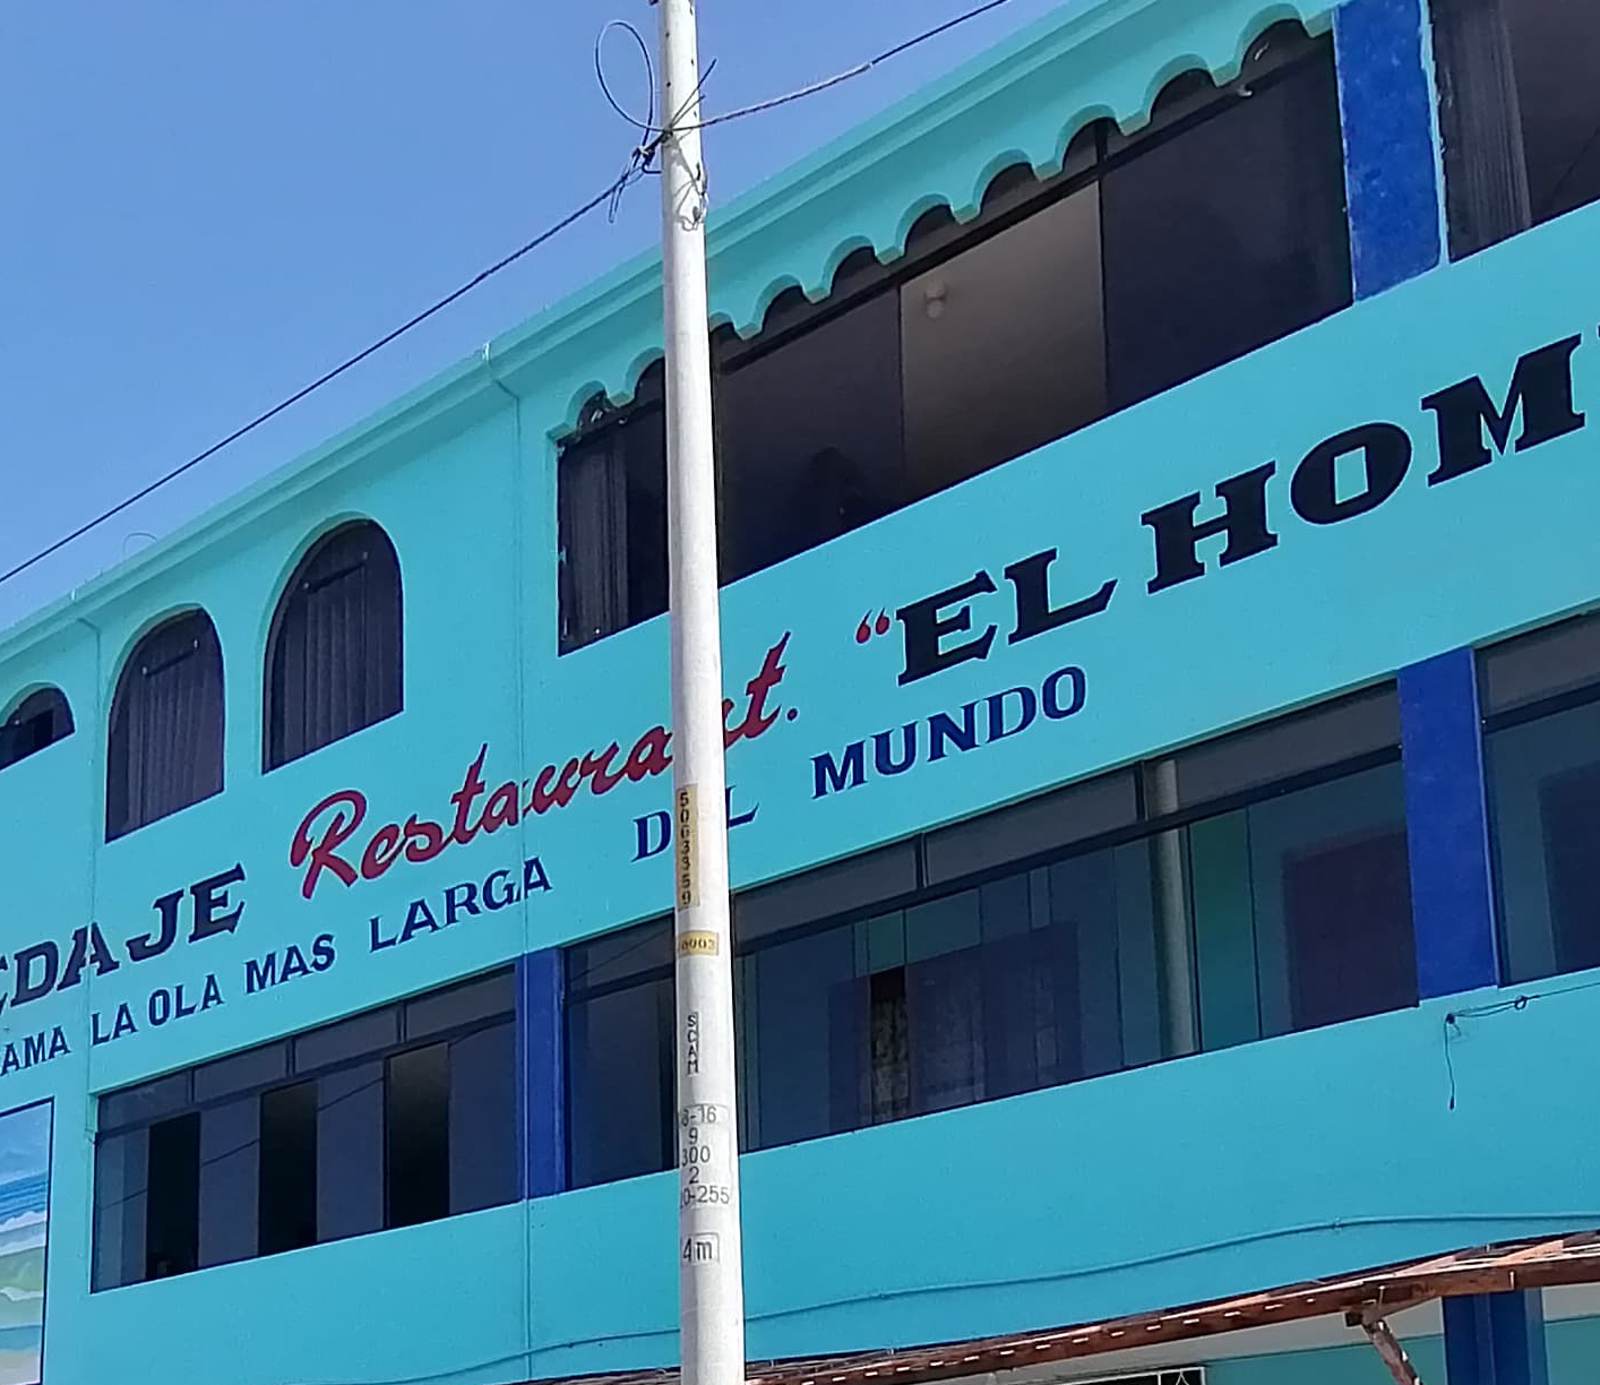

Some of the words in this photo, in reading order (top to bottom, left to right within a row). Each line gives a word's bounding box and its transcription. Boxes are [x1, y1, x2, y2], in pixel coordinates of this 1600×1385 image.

[0, 862, 246, 1014] DAJE
[290, 631, 799, 899] Restaurat.
[1140, 324, 1600, 594] HOM
[91, 1002, 138, 1046] LA
[149, 973, 225, 1026] OLA
[245, 934, 336, 994] MAS
[369, 856, 552, 952] LARGA
[632, 785, 760, 862] DL
[811, 666, 1087, 800] MUNDO
[688, 1127, 698, 1145] 9
[688, 1166, 700, 1184] 2
